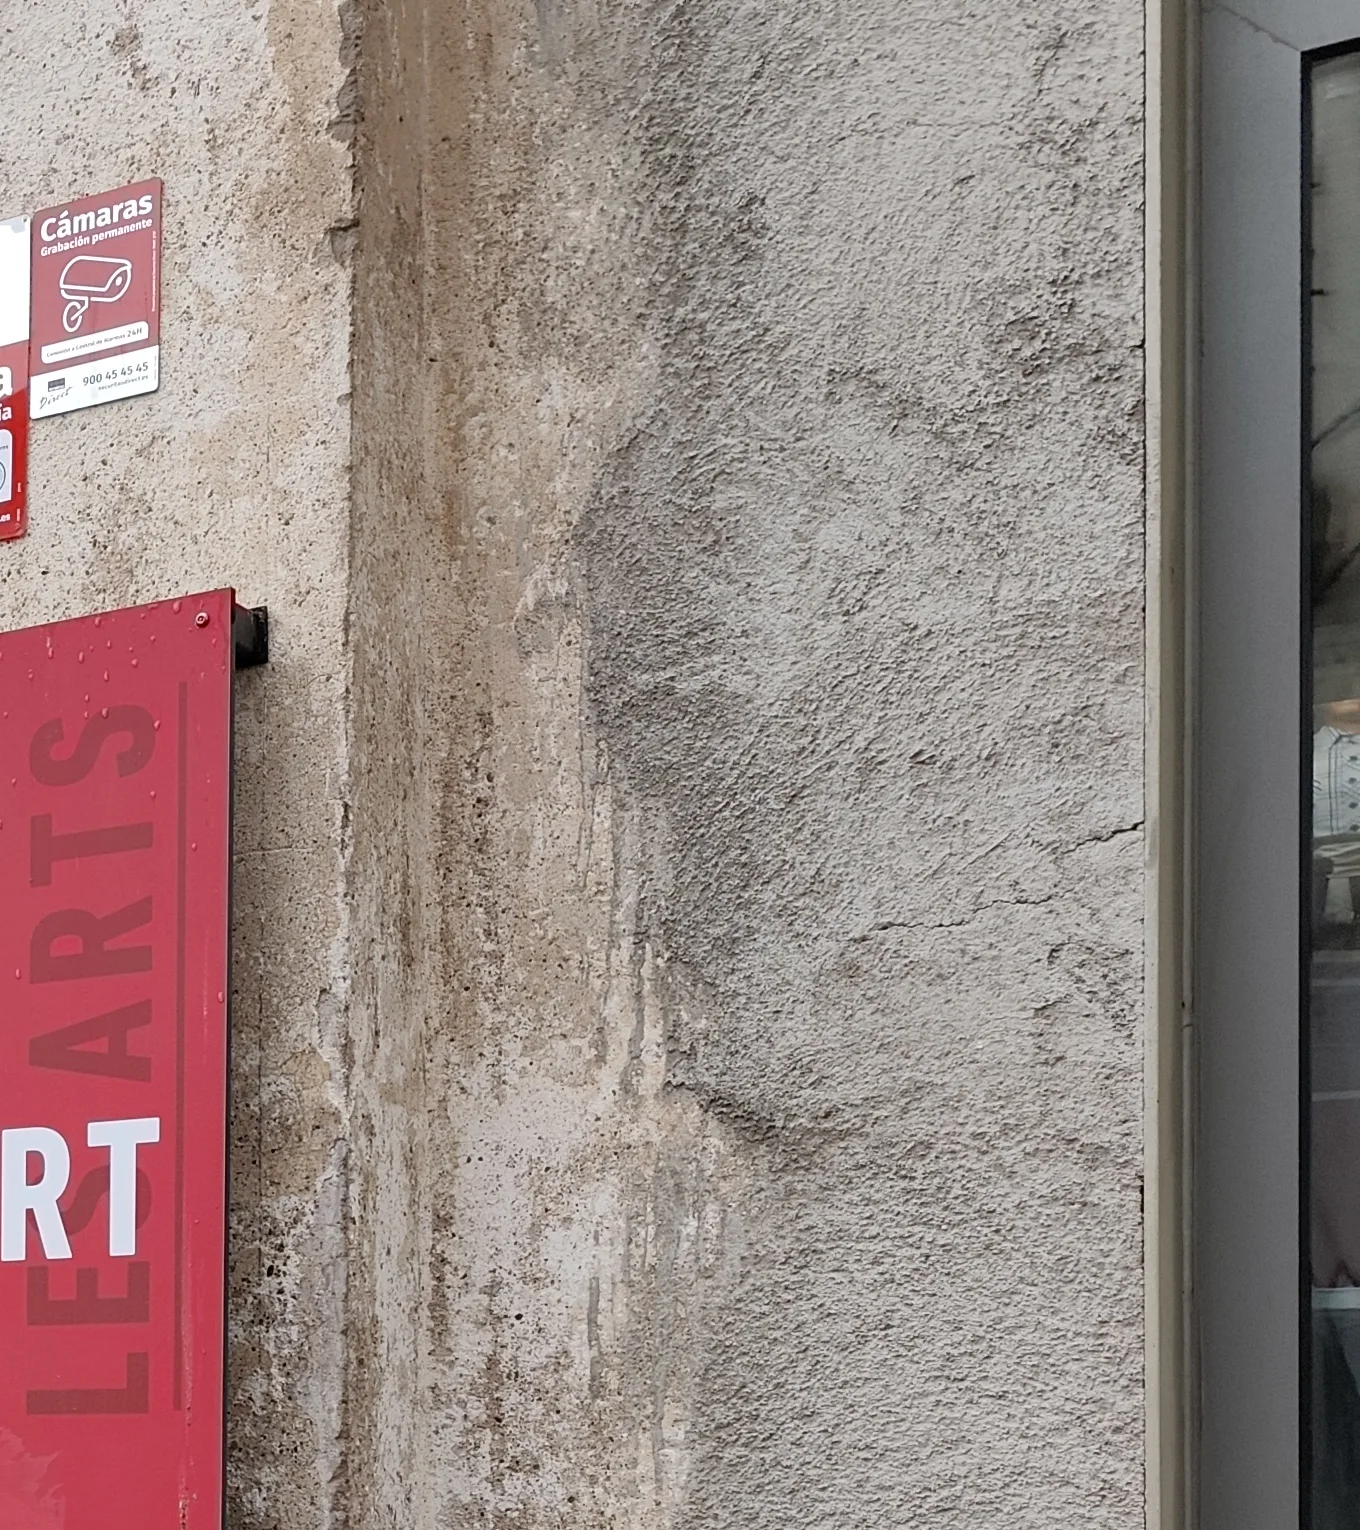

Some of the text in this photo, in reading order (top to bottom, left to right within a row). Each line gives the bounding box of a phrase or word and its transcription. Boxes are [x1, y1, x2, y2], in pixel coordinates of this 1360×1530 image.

[41, 194, 153, 242] Cámaras
[41, 218, 153, 257] Grabación permanente
[127, 327, 142, 338] 24H
[83, 373, 102, 387] 900
[105, 369, 118, 380] 45
[121, 365, 133, 377] 45
[136, 361, 149, 372] 45
[28, 703, 156, 1083] ARTS
